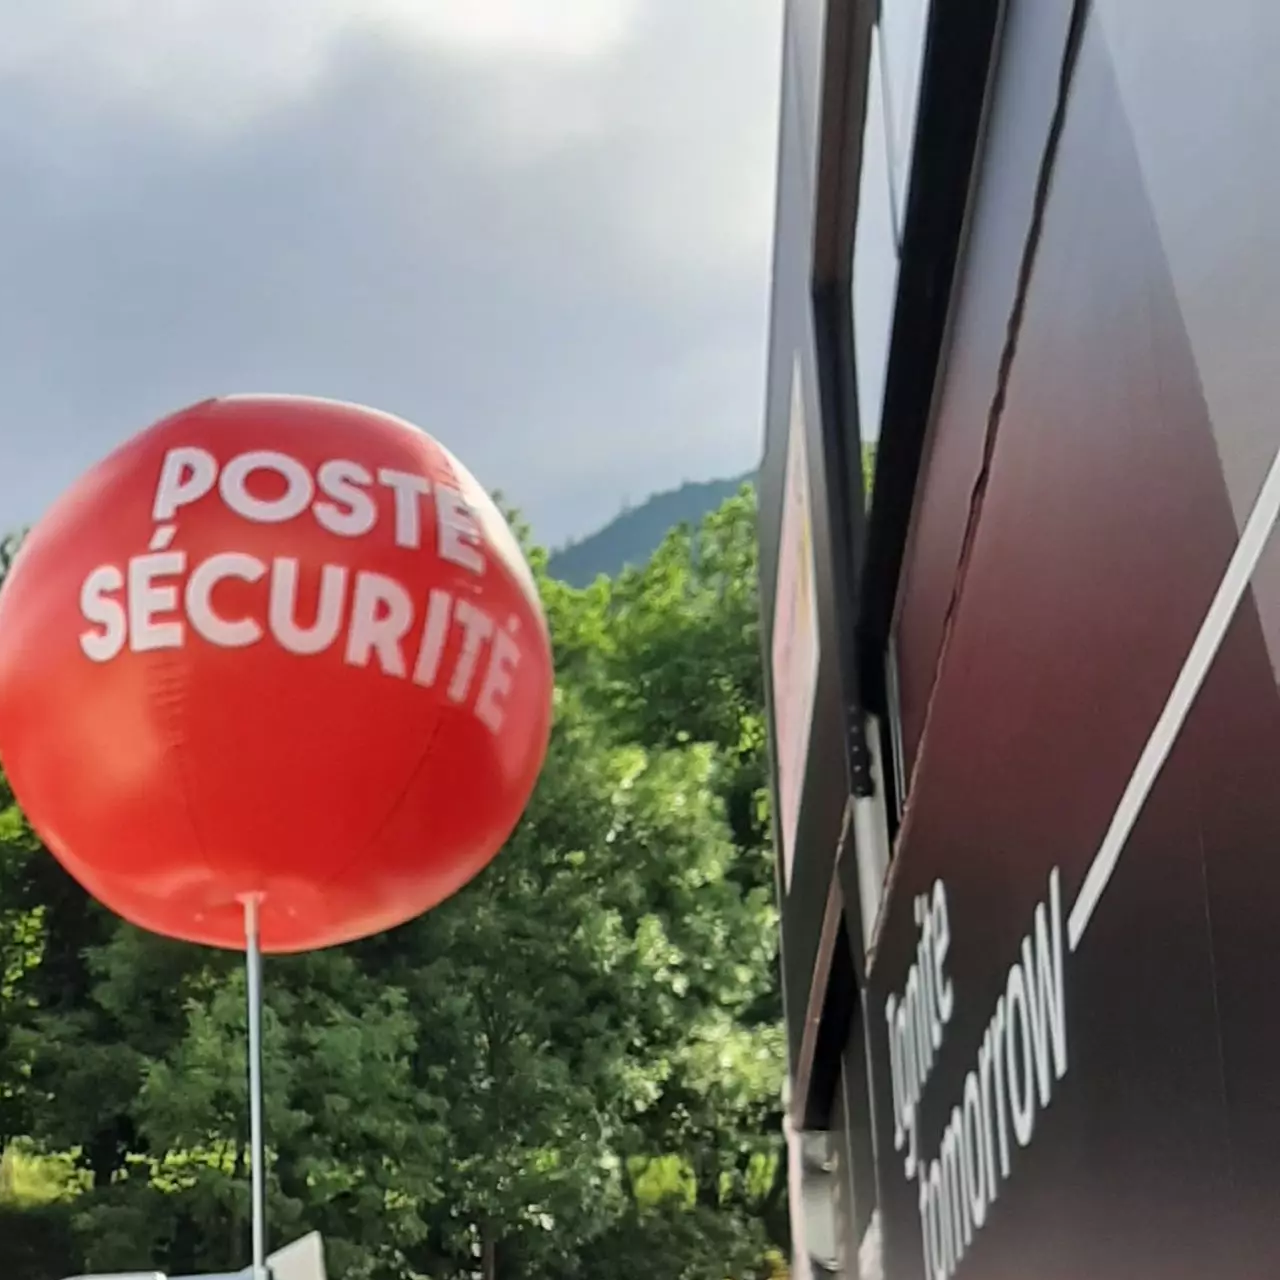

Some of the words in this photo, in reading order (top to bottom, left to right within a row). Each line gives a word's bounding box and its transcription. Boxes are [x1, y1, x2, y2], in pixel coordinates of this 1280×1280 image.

[152, 447, 486, 575] POSTE
[79, 525, 522, 736] SÉCURITÉ
[885, 878, 954, 1180] ignite
